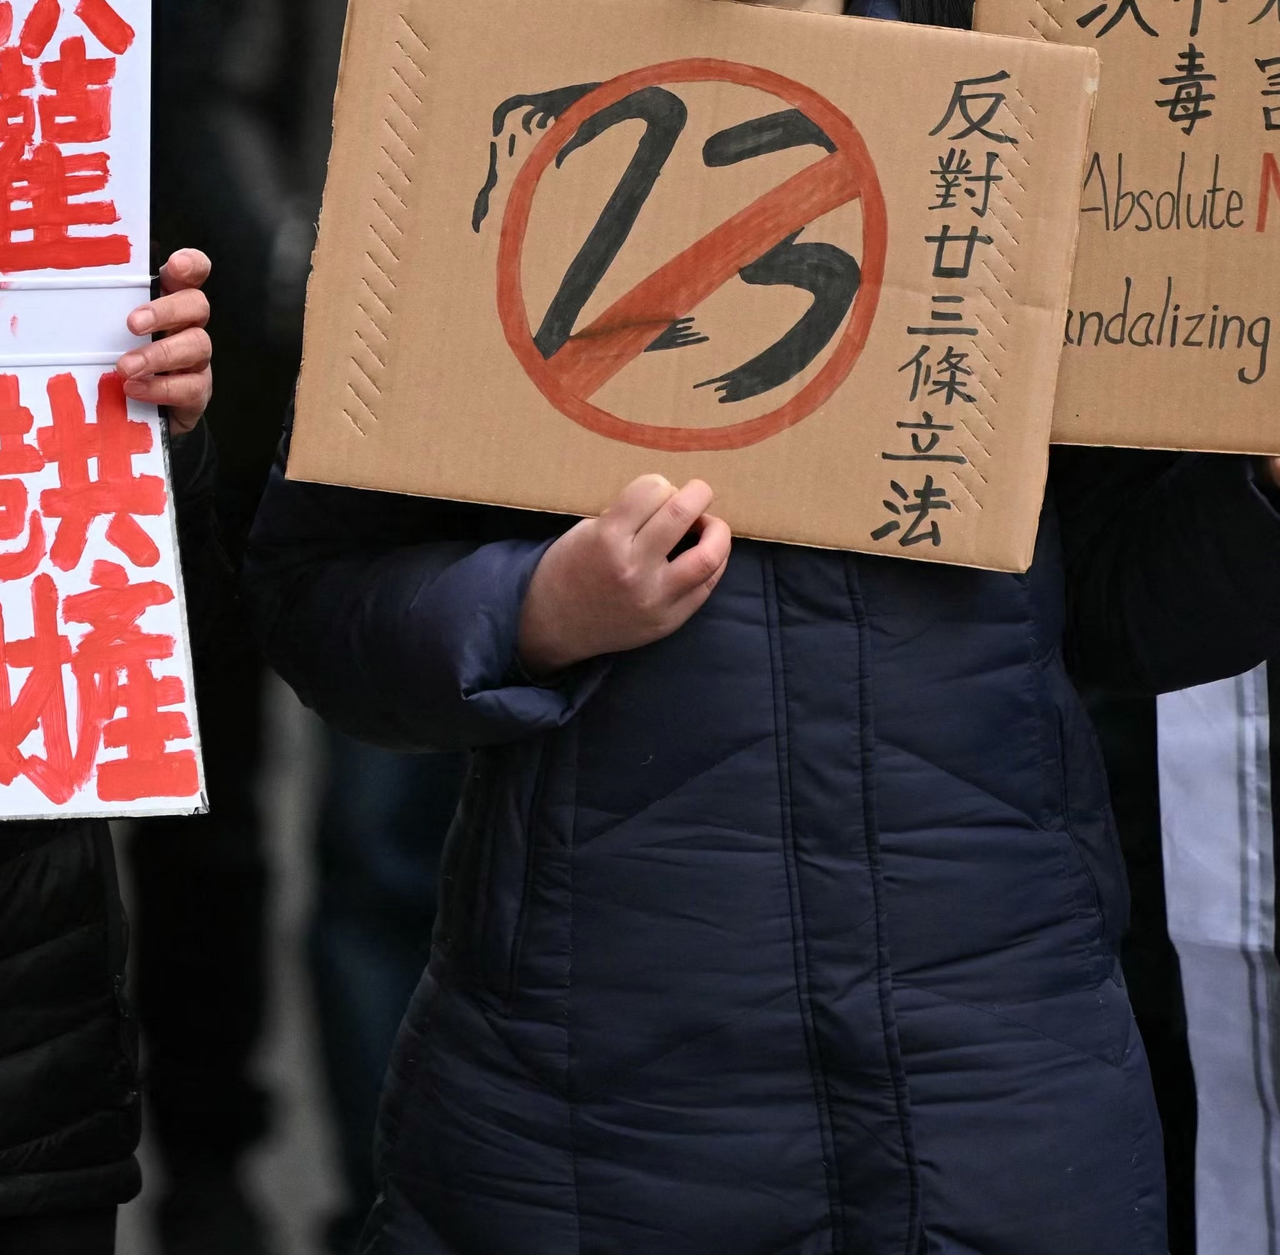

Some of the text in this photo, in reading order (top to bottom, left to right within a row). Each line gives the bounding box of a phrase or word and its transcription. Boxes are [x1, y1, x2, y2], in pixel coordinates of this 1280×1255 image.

[471, 81, 862, 405] 23
[870, 70, 1018, 547] 反對廿三條立法
[1081, 151, 1244, 232] Absolute
